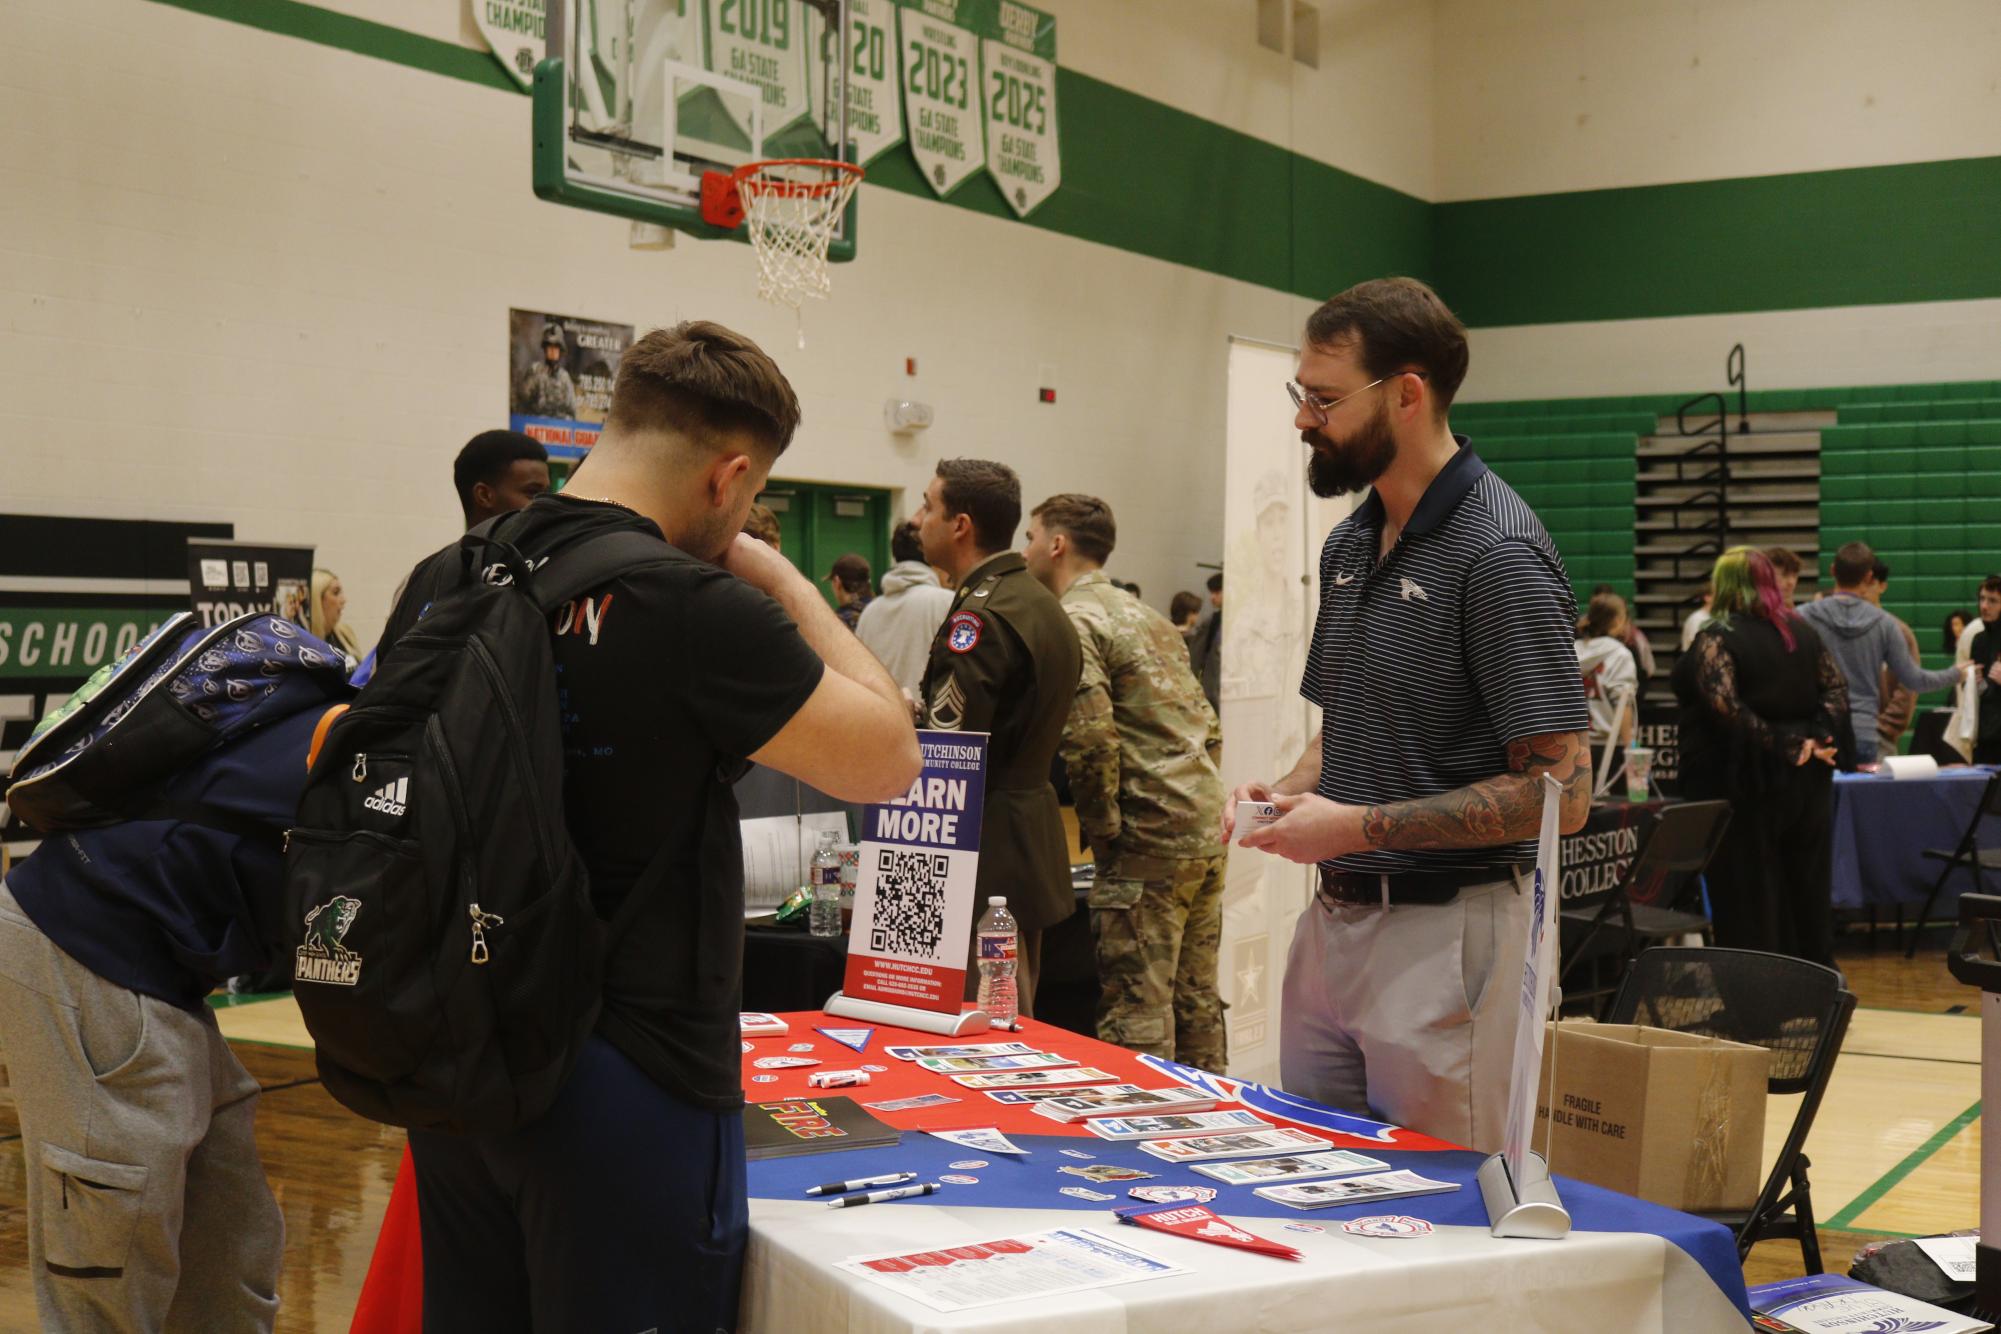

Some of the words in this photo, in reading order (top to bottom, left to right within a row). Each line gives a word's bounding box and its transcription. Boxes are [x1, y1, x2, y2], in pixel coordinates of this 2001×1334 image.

[720, 0, 789, 50] 2019
[749, 53, 779, 82] STATE
[910, 41, 968, 109] 2023
[992, 69, 1046, 136] 2025
[935, 112, 958, 138] STATE
[914, 126, 967, 162] CHAMPIONS
[1016, 138, 1037, 163] STATE
[997, 153, 1046, 185] CHAMPIONS
[577, 333, 622, 351] GREATER
[525, 423, 572, 445] NATIONAL
[0, 621, 159, 667] SCHOO
[920, 743, 982, 761] UTCHINSON
[950, 761, 981, 771] COLLEGE
[364, 796, 407, 817] adidas
[876, 808, 959, 845] MORE
[1560, 826, 1640, 867] HESSTON
[298, 956, 361, 983] PANTHERS
[1563, 1093, 1602, 1116] FRAGILE
[758, 1100, 849, 1140] FIRE
[1575, 1114, 1600, 1134] WITH
[1600, 1120, 1626, 1140] CARE
[1148, 1207, 1209, 1224] HUTCH
[1818, 1306, 1904, 1329] HUTCHINSON
